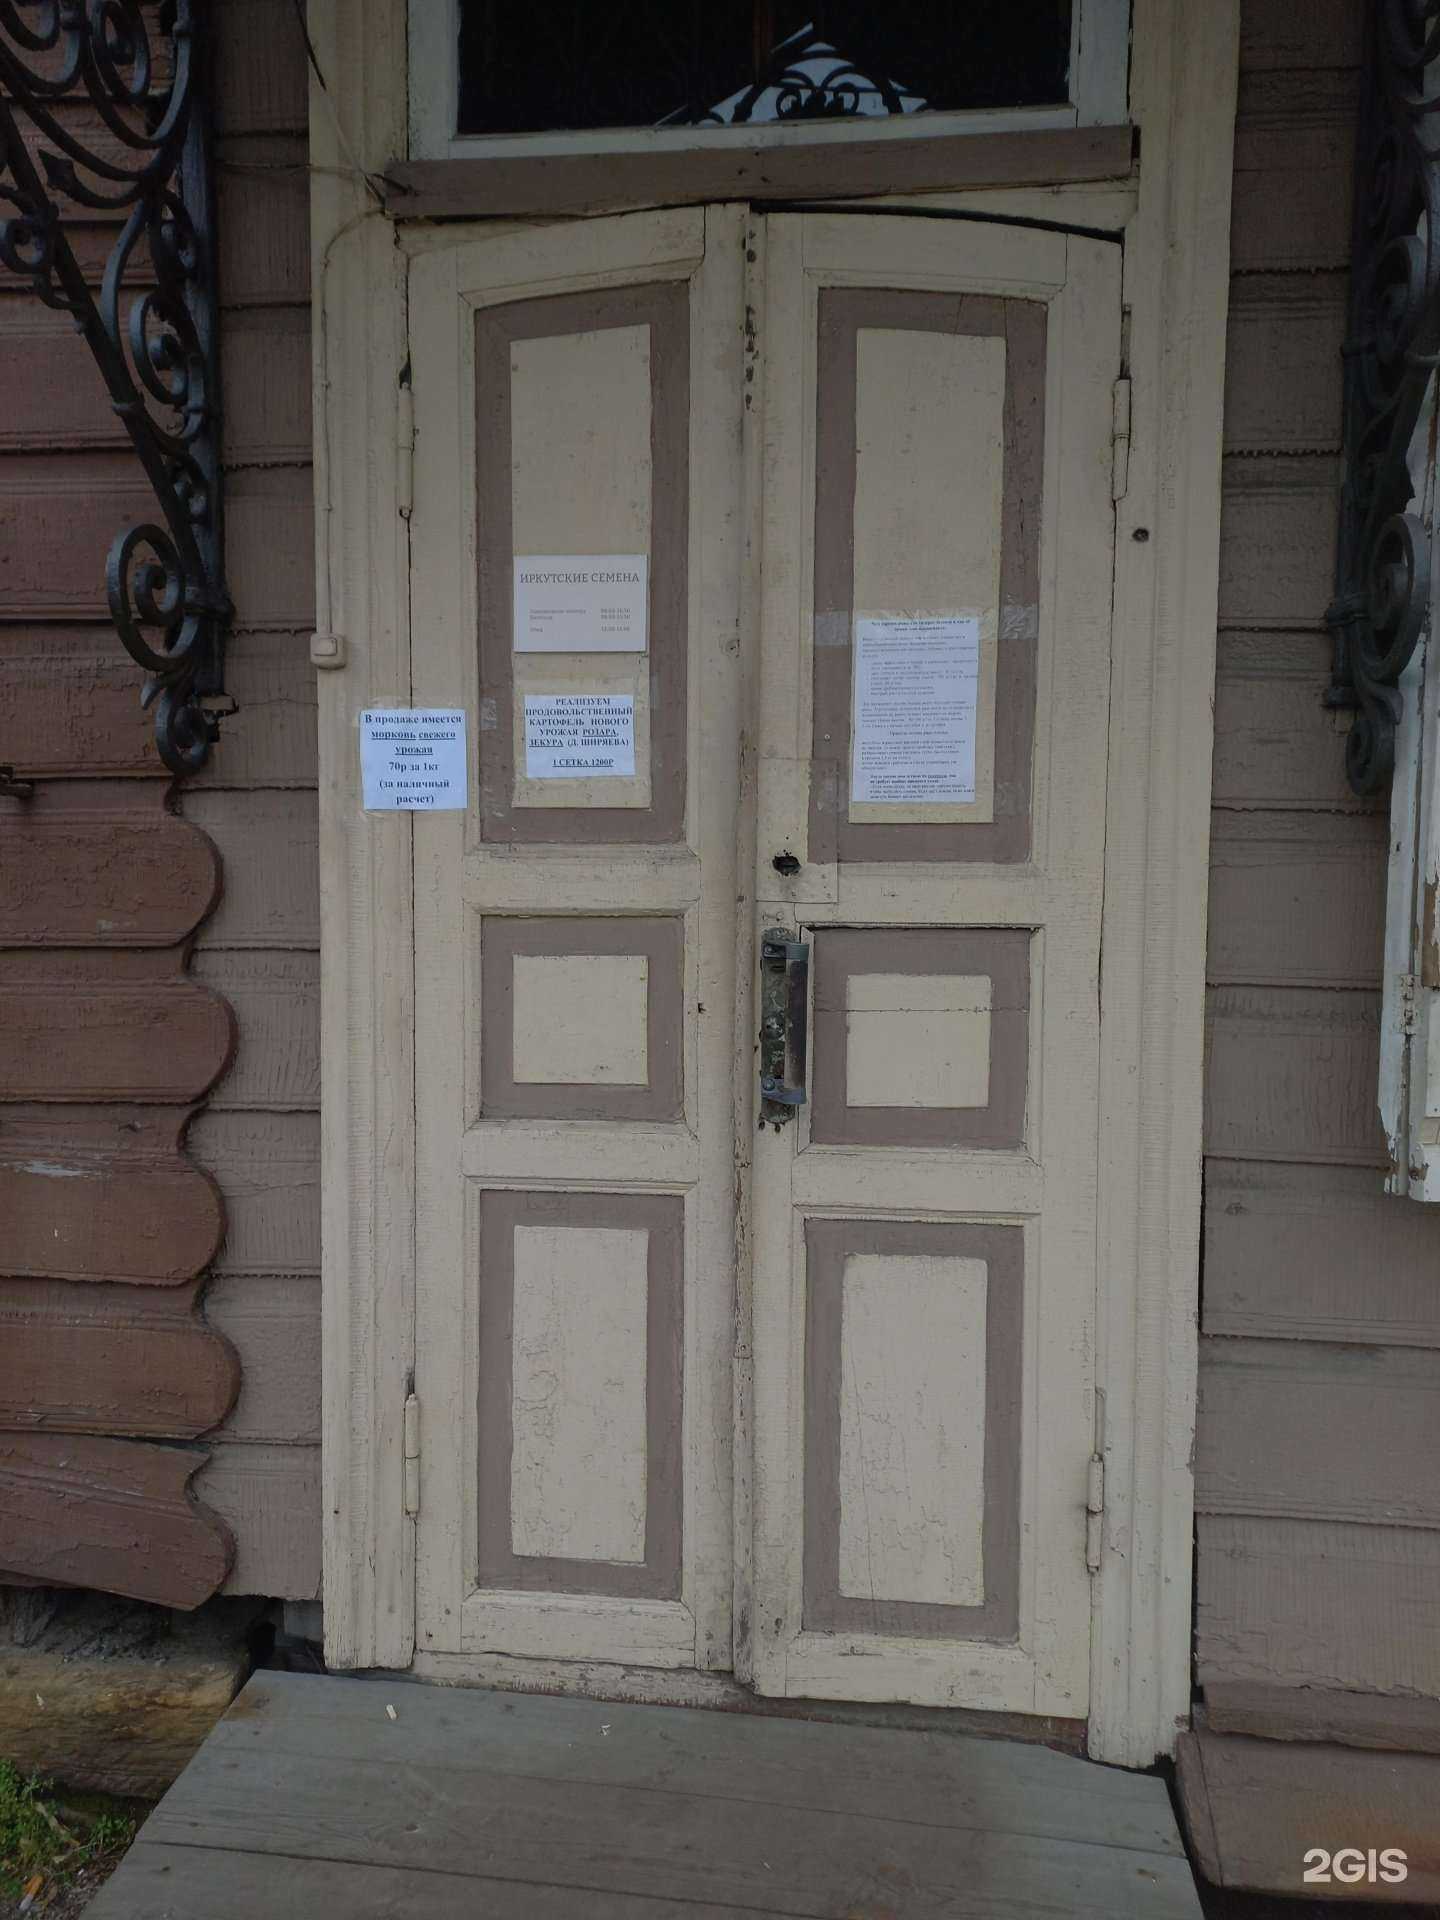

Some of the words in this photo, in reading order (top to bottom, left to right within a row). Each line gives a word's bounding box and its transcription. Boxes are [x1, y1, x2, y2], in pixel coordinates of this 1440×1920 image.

[520, 573, 589, 584] ИРКУТСКИЕ
[591, 572, 640, 583] СЕМЕНА
[555, 697, 611, 706] РЕАЛИЗУЕМ
[525, 706, 632, 716] ПРОДОВОЛЬСТВЕННЫЙ
[365, 714, 373, 724] В
[375, 716, 419, 726] продаже
[422, 715, 462, 724] имеется
[529, 718, 585, 726] КАРТОФЕЛЬ
[591, 718, 629, 726] НОВОГО
[371, 731, 416, 741] морковь
[418, 731, 456, 741] свежего
[539, 728, 578, 737] УРОЖАЯ
[528, 738, 564, 748] ЗЕКУРА
[581, 738, 629, 747] ШИРЯЕВА)
[388, 762, 407, 773] 70р
[423, 762, 440, 771] 1кг
[558, 759, 589, 768] СЕТКА
[379, 779, 394, 790] (за
[397, 779, 450, 789] наличный
[396, 794, 434, 806] расчет)
